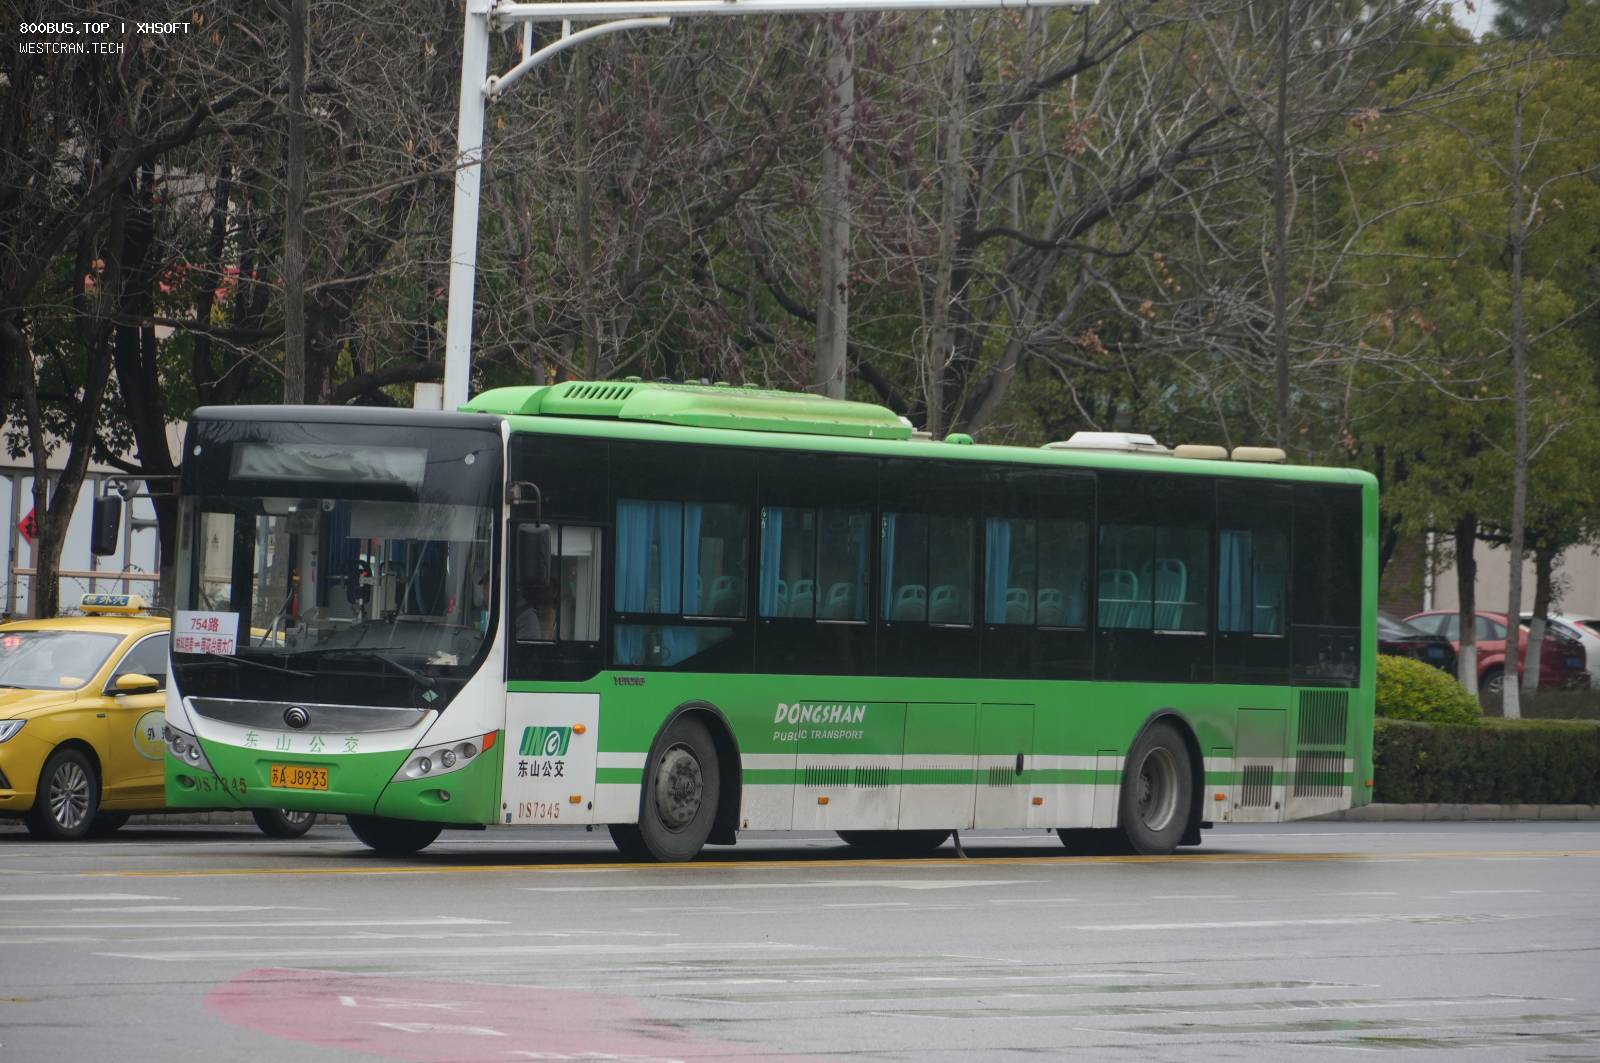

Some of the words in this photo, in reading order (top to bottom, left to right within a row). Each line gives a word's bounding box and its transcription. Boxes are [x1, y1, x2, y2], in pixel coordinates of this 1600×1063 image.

[191, 617, 219, 632] 754路
[774, 703, 866, 724] DONGSHAN
[244, 731, 359, 752] 东山公交
[773, 729, 808, 742] PUBLIC
[811, 729, 864, 740] TRANSPORT
[517, 760, 565, 778] 东山公交
[518, 802, 561, 819] DS7345
